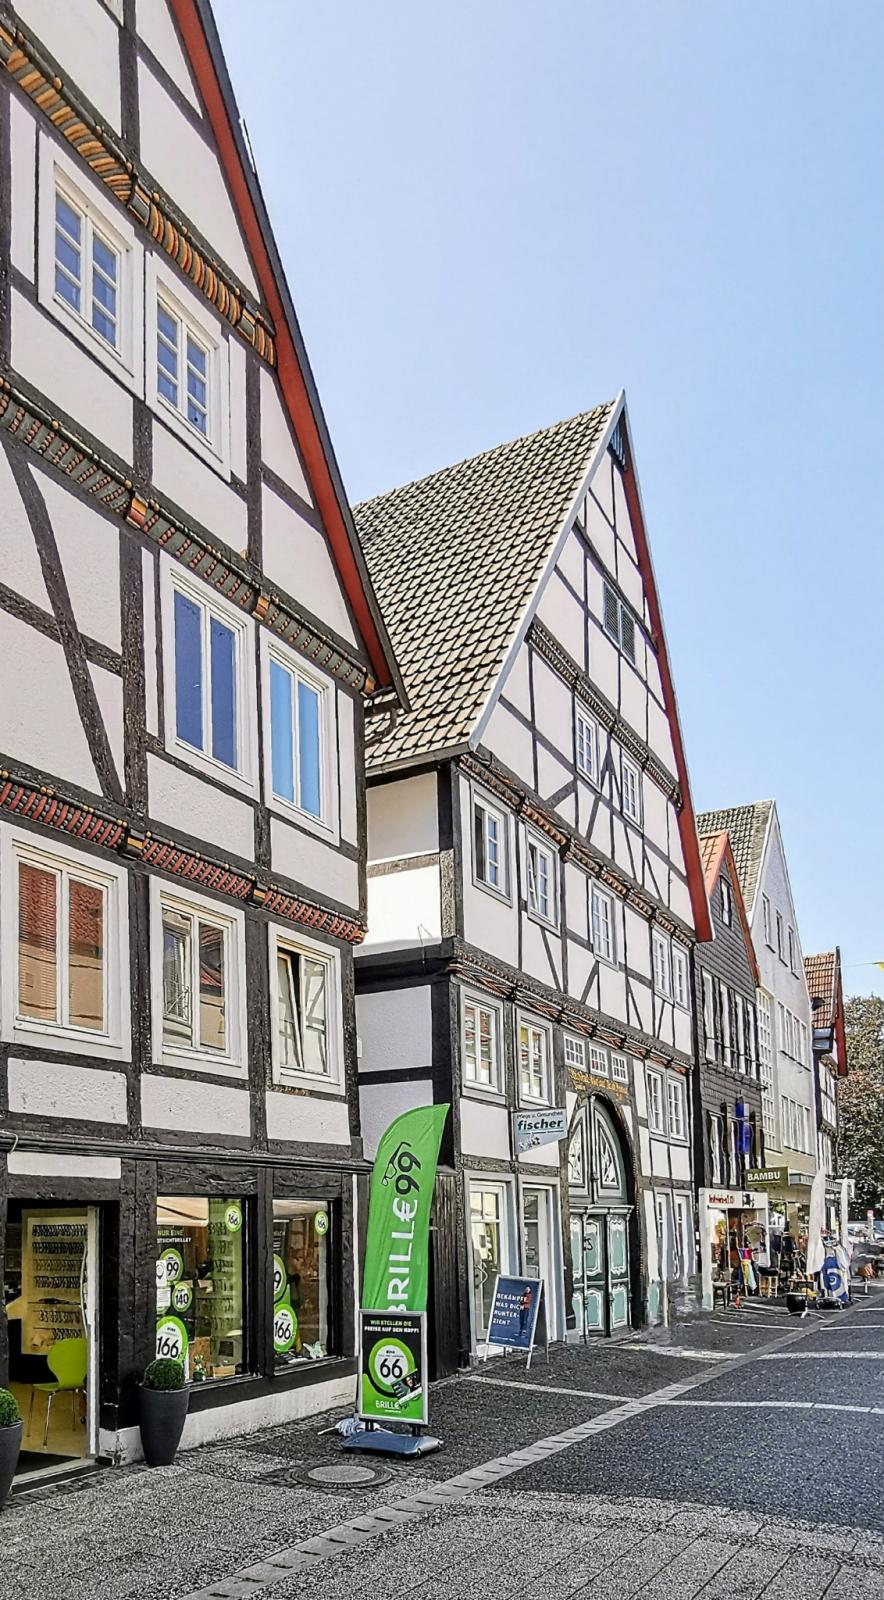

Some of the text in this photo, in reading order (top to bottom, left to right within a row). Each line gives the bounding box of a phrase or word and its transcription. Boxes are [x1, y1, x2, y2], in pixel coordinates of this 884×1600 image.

[518, 1118, 563, 1131] fischer
[747, 1171, 780, 1181] BAMBU
[166, 1262, 179, 1277] 99
[175, 1293, 189, 1305] 140
[380, 1358, 403, 1379] 66
